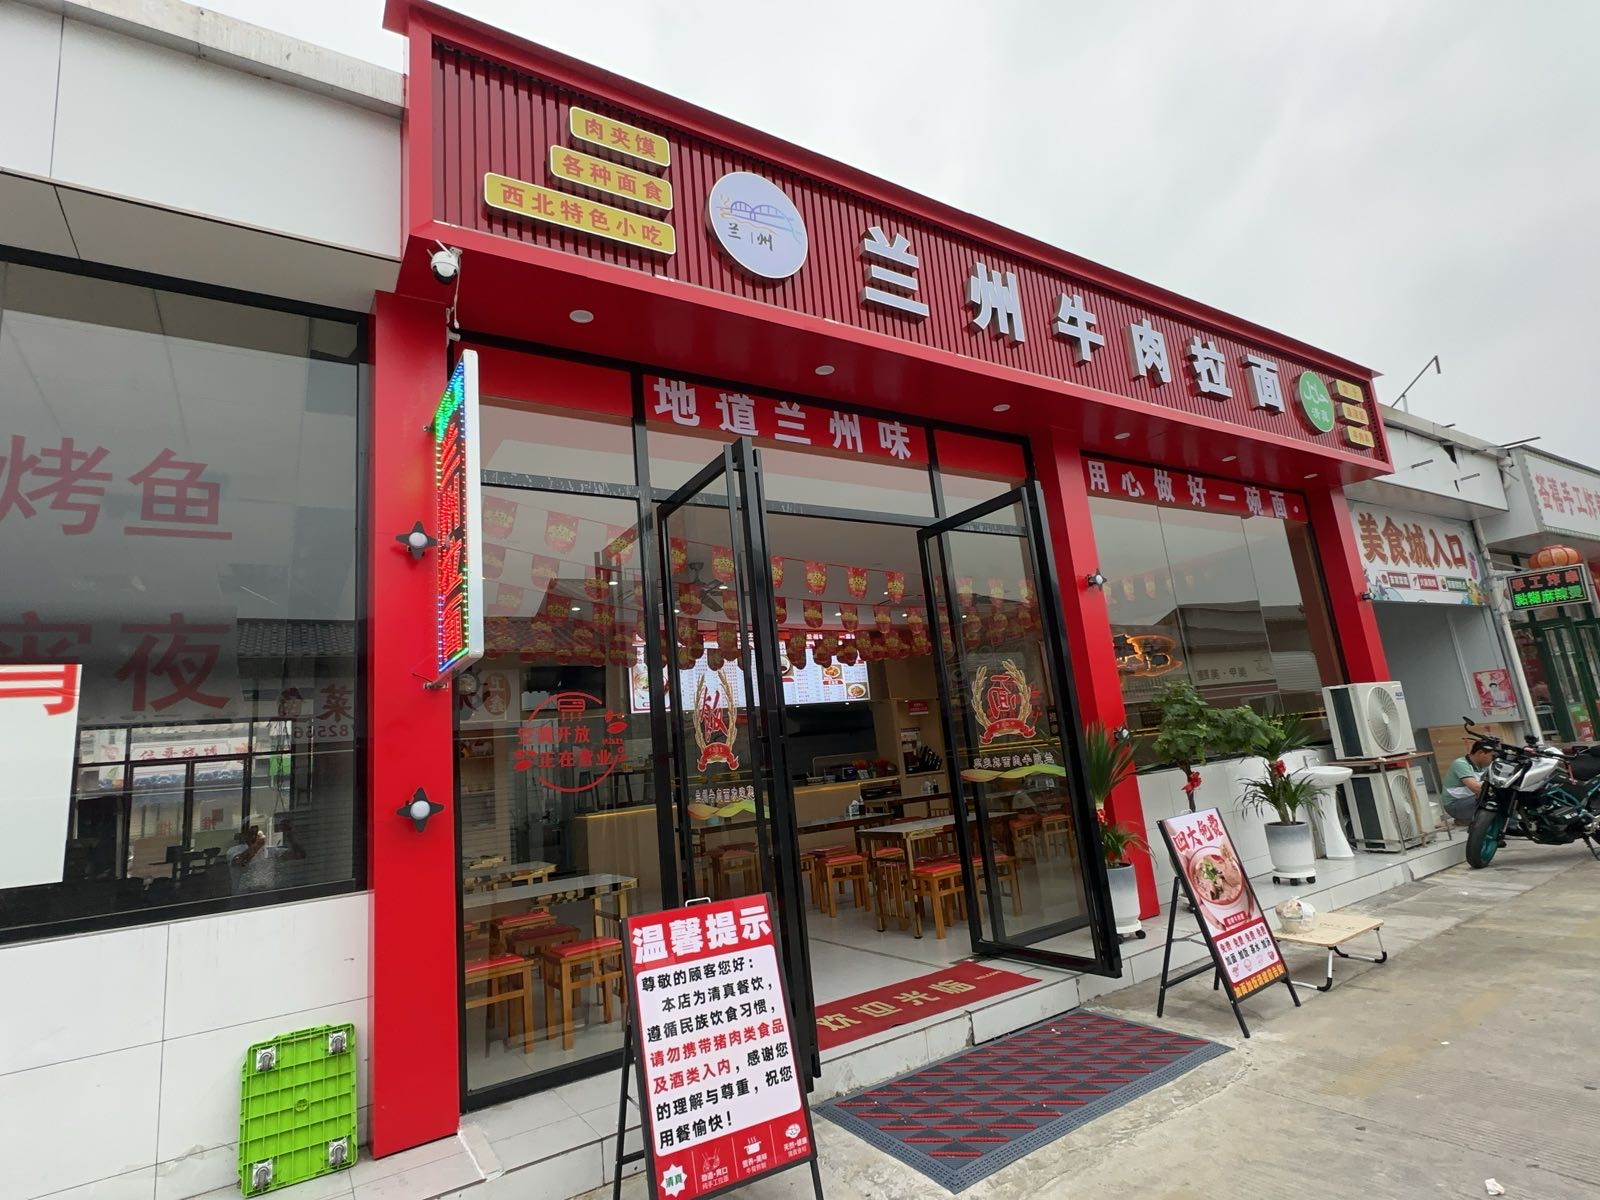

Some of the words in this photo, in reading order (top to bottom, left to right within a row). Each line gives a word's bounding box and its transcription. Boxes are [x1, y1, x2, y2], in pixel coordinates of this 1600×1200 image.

[584, 117, 658, 159] 肉夹馍
[562, 153, 663, 202] 各种面食
[500, 183, 664, 247] 西北特色小吃
[861, 226, 1285, 413] 兰州牛肉拉面
[653, 377, 912, 460] 地道兰州味
[0, 435, 232, 541] 烤鱼
[1358, 512, 1468, 570] 美食城入口
[631, 904, 772, 965] 温馨提示
[641, 957, 754, 992] 尊敬的顾客您好：
[661, 977, 773, 1013] 本店为清真餐饮，
[647, 999, 776, 1043] 遵循民族饮食习惯，
[816, 979, 976, 1031] 欢迎光临
[650, 1018, 785, 1068] 请勿携带猪肉类食品
[653, 1042, 789, 1094] 及酒类入内，感谢您
[656, 1065, 793, 1121] 的理解与尊重，祝您
[659, 1111, 732, 1150] 用餐愉快！
[665, 1173, 683, 1188] 清真
